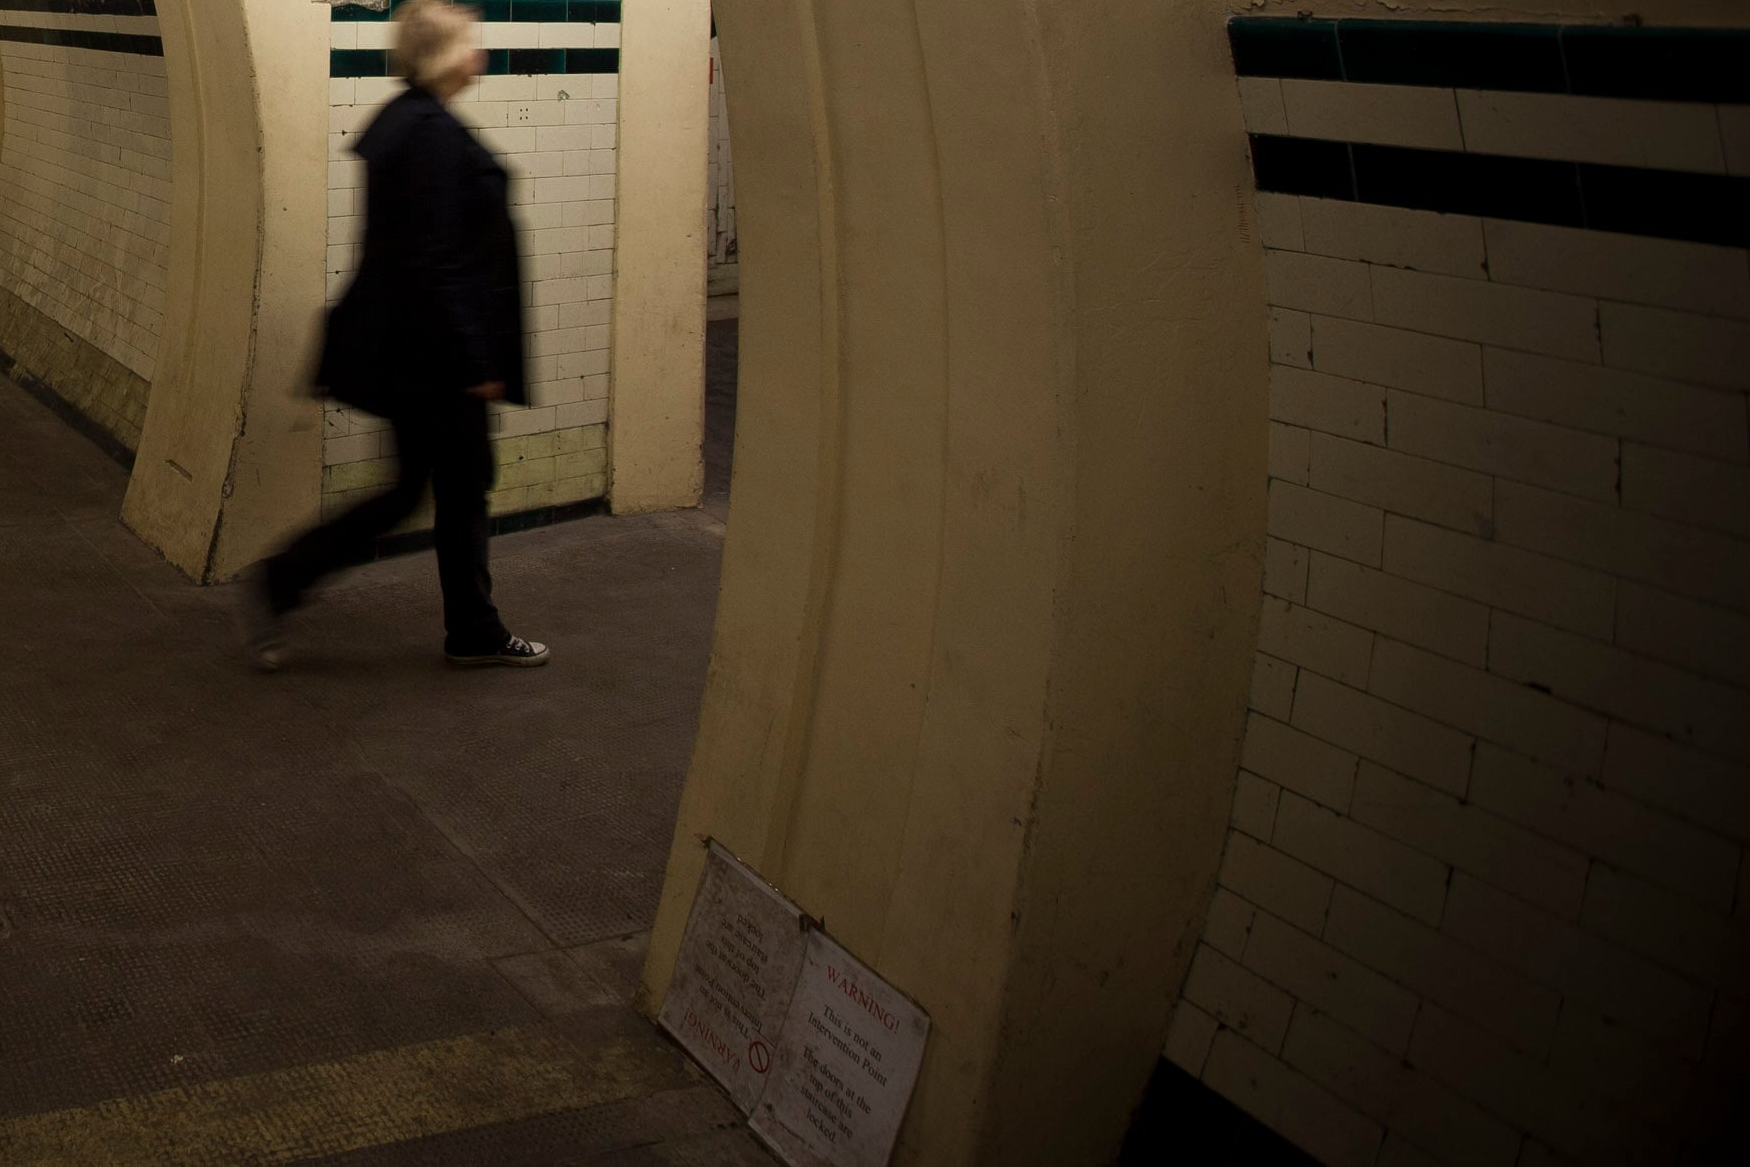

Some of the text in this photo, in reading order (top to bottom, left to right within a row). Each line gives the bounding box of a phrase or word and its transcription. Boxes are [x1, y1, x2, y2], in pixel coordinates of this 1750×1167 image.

[828, 965, 900, 1034] WARNING!
[808, 1012, 888, 1087] Intervention Point
[824, 1005, 882, 1061] This is not an
[803, 1046, 871, 1115] The doors at the
[809, 1073, 852, 1119] top of this
[800, 1086, 853, 1139] staircase are
